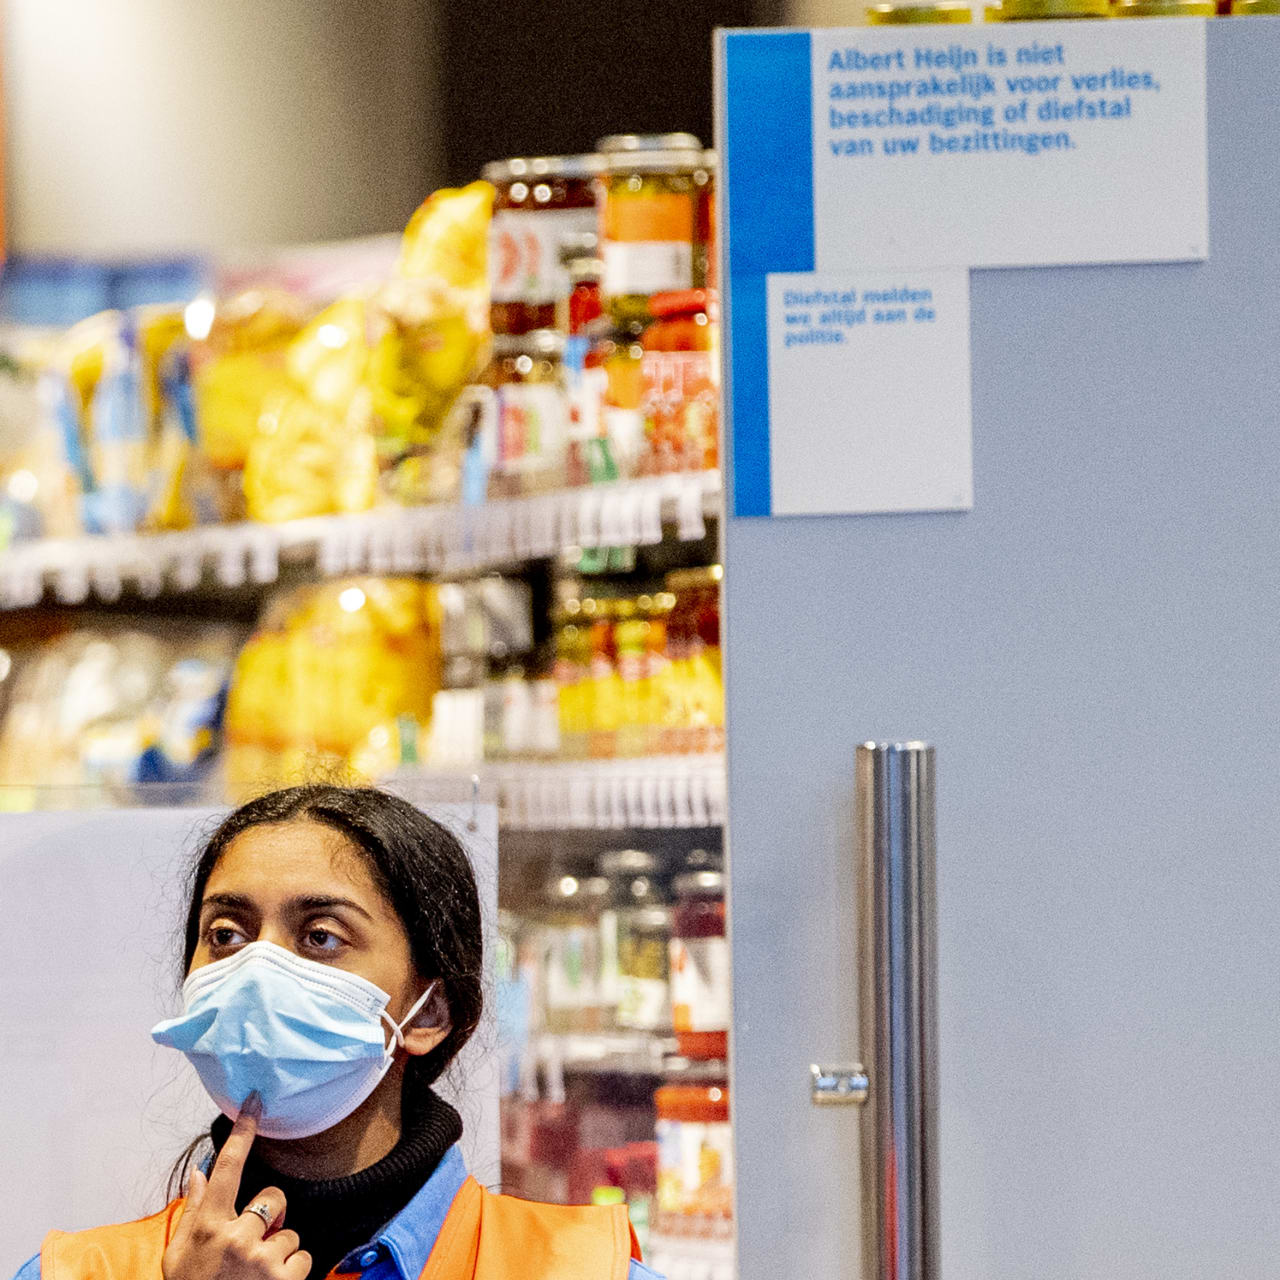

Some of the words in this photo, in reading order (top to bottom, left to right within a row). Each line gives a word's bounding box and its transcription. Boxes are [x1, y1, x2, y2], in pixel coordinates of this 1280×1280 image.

[828, 47, 904, 71] Albert
[914, 45, 978, 72] Heijn
[987, 42, 1007, 66] is
[1016, 41, 1064, 65] niet
[829, 74, 995, 105] aansprakelijk
[1005, 74, 1060, 93] voor
[1071, 68, 1160, 93] verlies,
[829, 100, 995, 128] beschadiging
[1003, 99, 1028, 123] of
[1037, 95, 1131, 122] diefstal
[829, 134, 873, 156] van
[883, 134, 919, 154] uw
[929, 129, 1077, 156] bezittingen.
